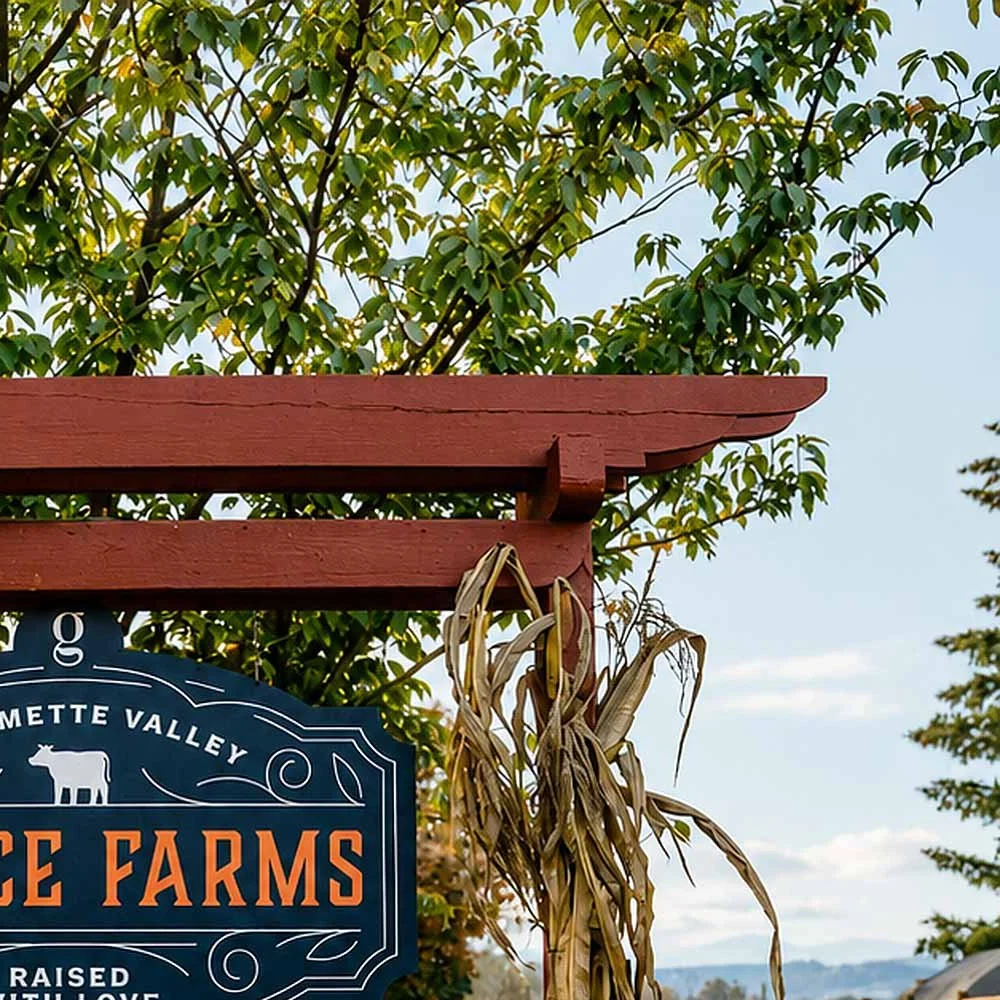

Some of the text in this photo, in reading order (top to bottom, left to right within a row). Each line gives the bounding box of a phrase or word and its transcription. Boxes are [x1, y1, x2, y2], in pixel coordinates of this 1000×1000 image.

[125, 708, 248, 765] VALLEY
[102, 829, 363, 907] FARMS
[10, 967, 129, 988] RAISED
